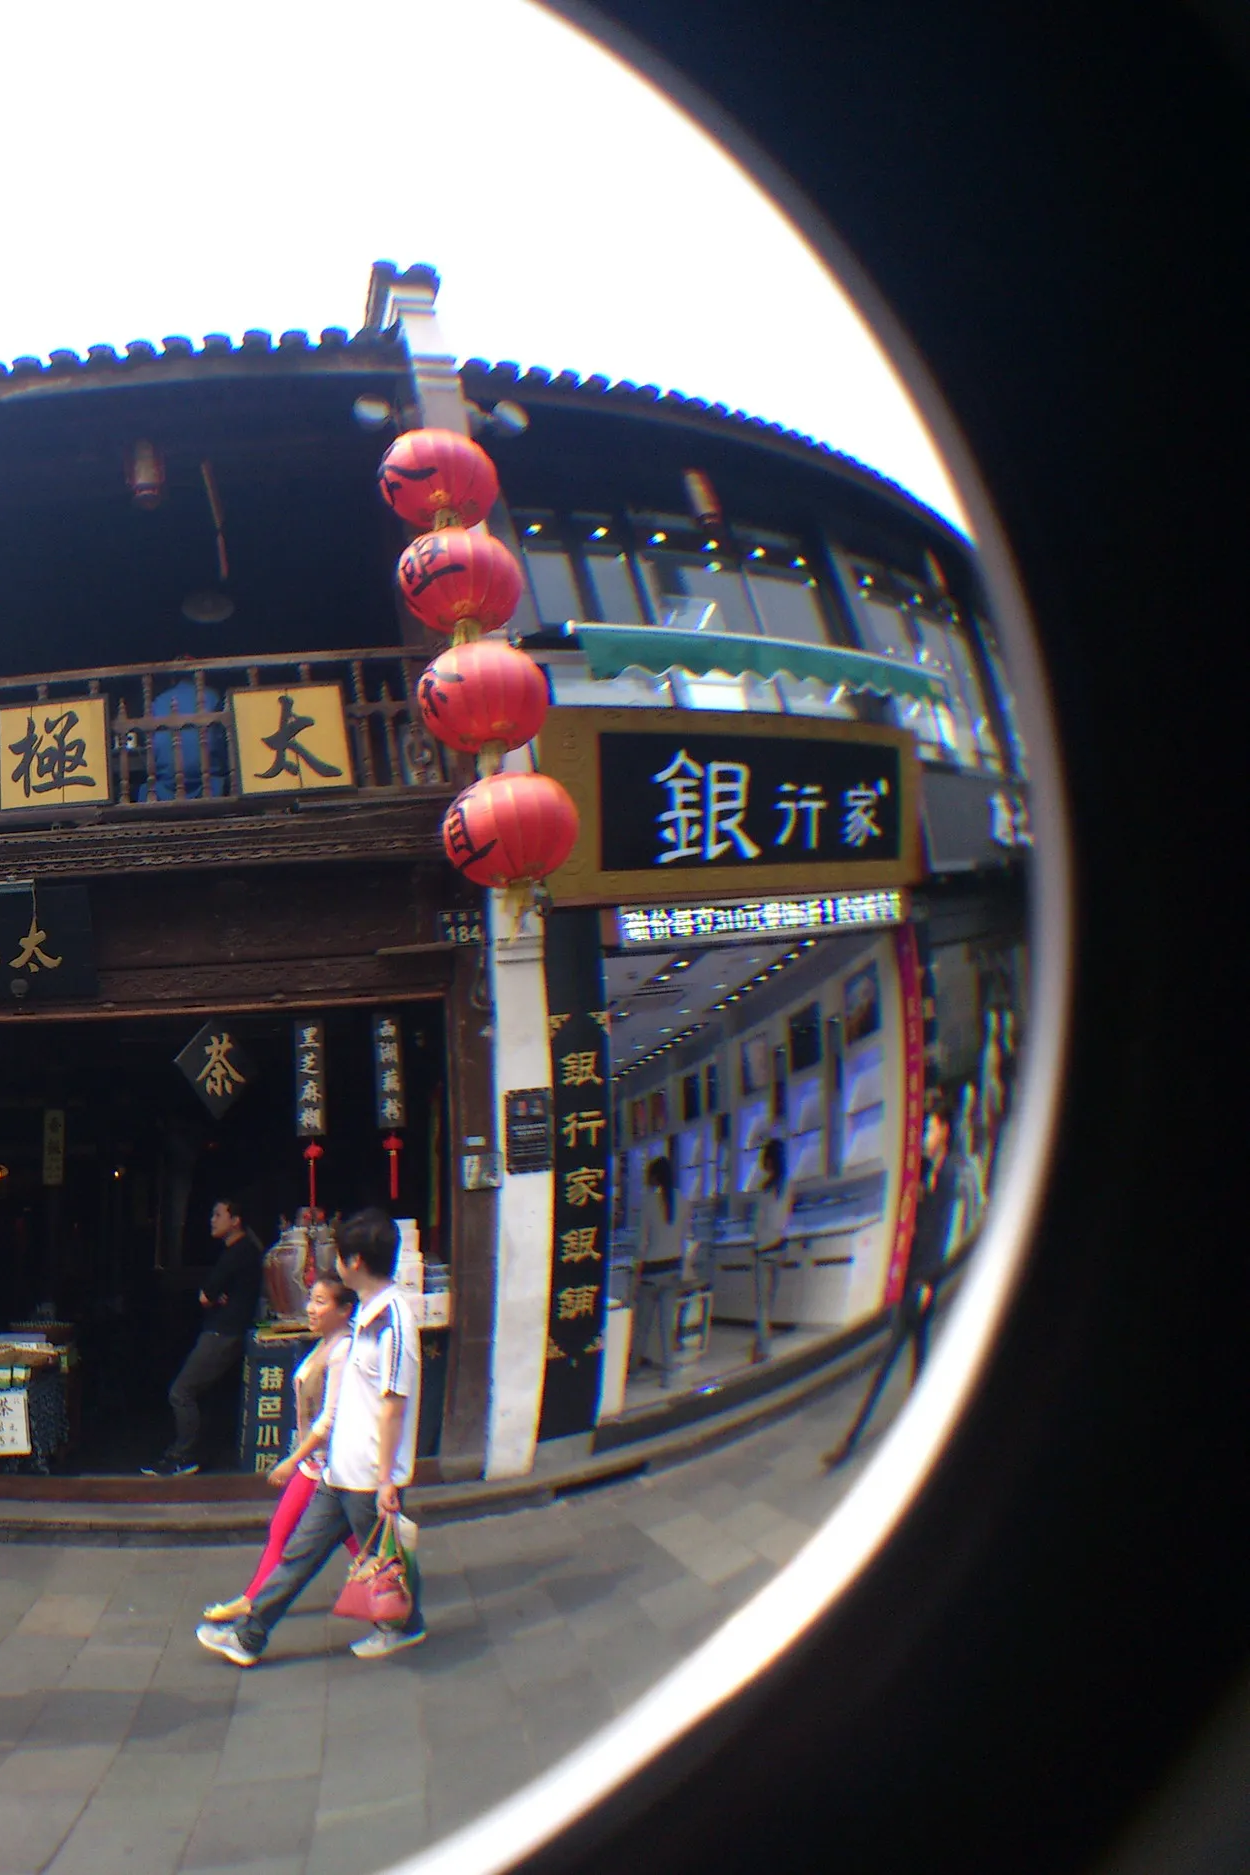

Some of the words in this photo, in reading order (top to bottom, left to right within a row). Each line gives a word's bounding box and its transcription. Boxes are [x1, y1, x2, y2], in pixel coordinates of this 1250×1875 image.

[8, 710, 97, 799] 極
[253, 694, 344, 780] 太
[653, 748, 890, 864] 銀行家
[195, 1032, 247, 1097] 茶
[299, 1026, 323, 1130] 黑芝麻糊
